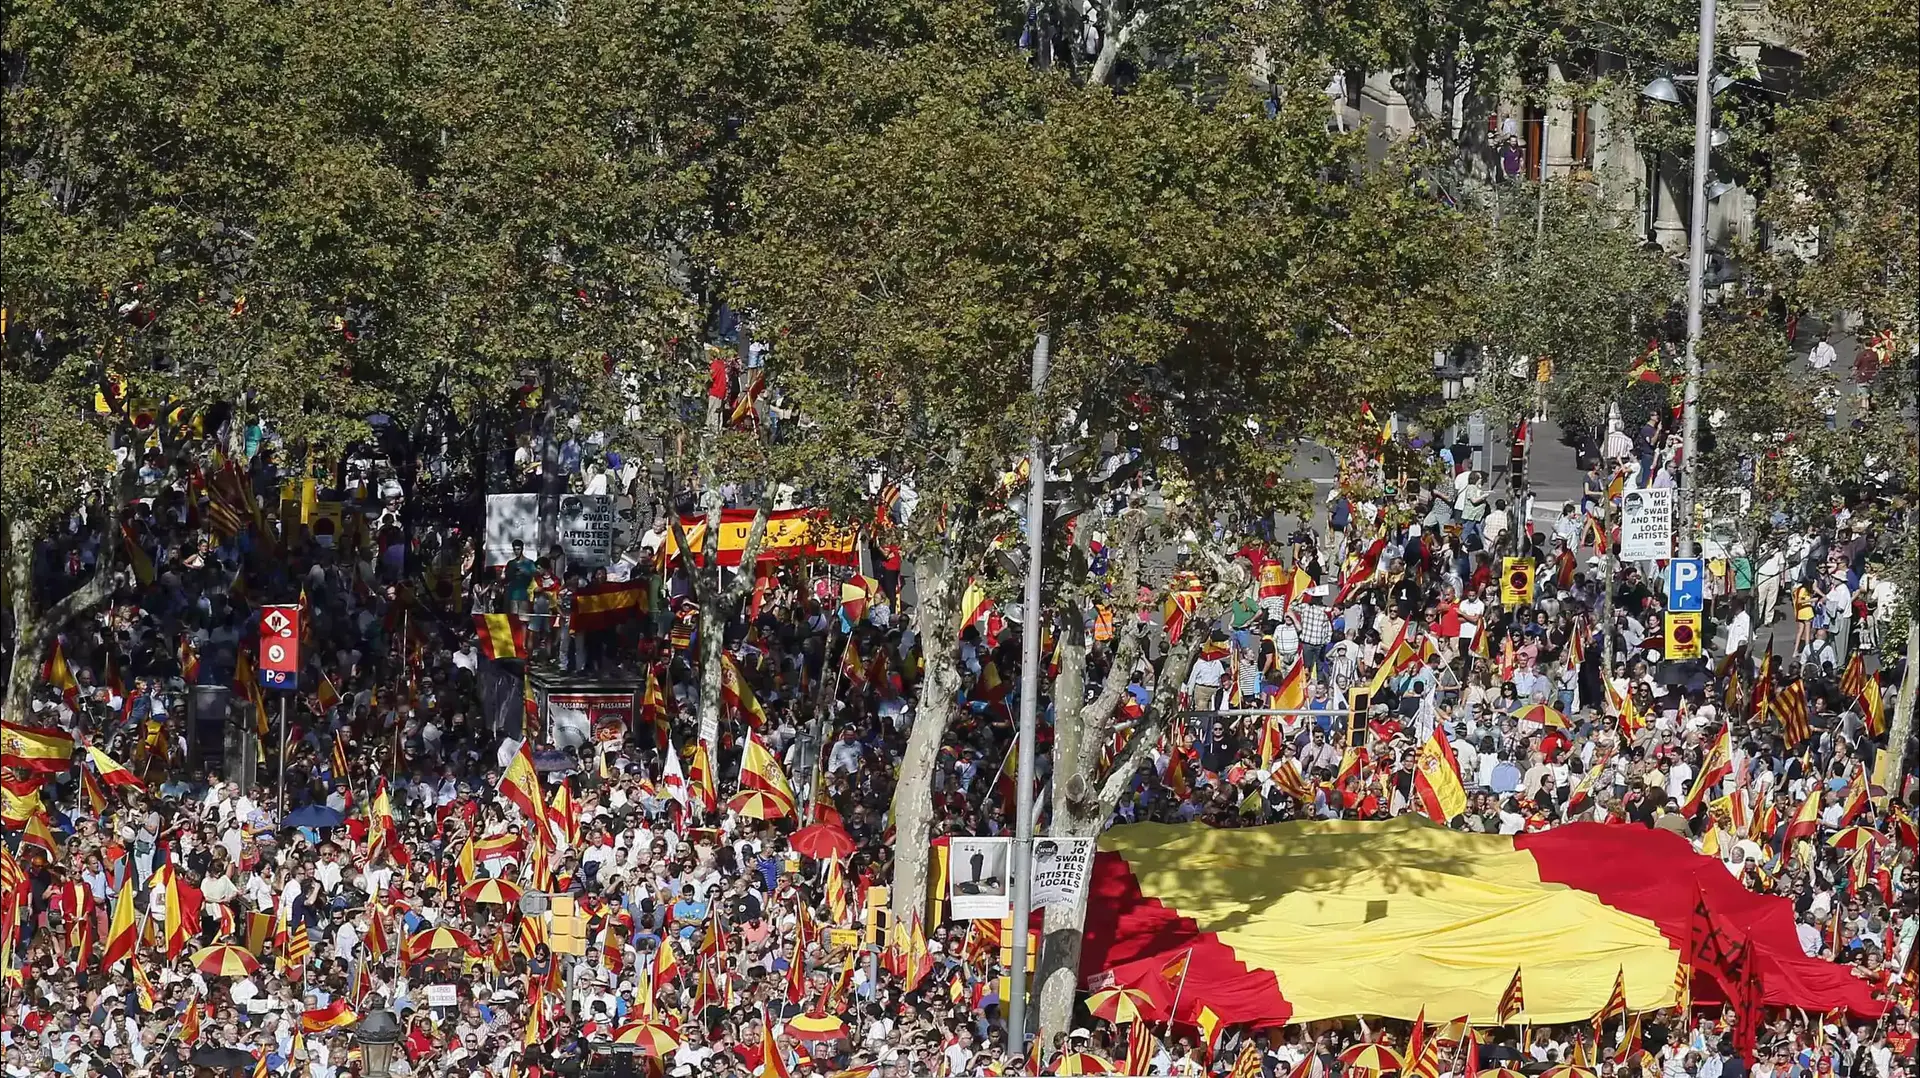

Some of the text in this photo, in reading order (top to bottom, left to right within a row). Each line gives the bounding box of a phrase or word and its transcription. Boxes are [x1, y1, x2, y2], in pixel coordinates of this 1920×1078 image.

[1648, 491, 1669, 499] YOU,
[1644, 507, 1669, 515] SWAB
[1640, 524, 1669, 532] LOCAL
[563, 531, 610, 539] ARTISTES
[1632, 532, 1669, 540] ARTISTS
[571, 539, 609, 547] LOCALS
[1675, 563, 1698, 591] P
[1400, 588, 1408, 600] 1
[272, 616, 281, 626] M
[266, 670, 275, 682] P
[1070, 847, 1087, 856] JO,
[1055, 855, 1085, 863] SWAB
[1064, 863, 1084, 871] ELS
[1035, 870, 1082, 882] ARTISTES
[1040, 878, 1080, 888] LOCALS
